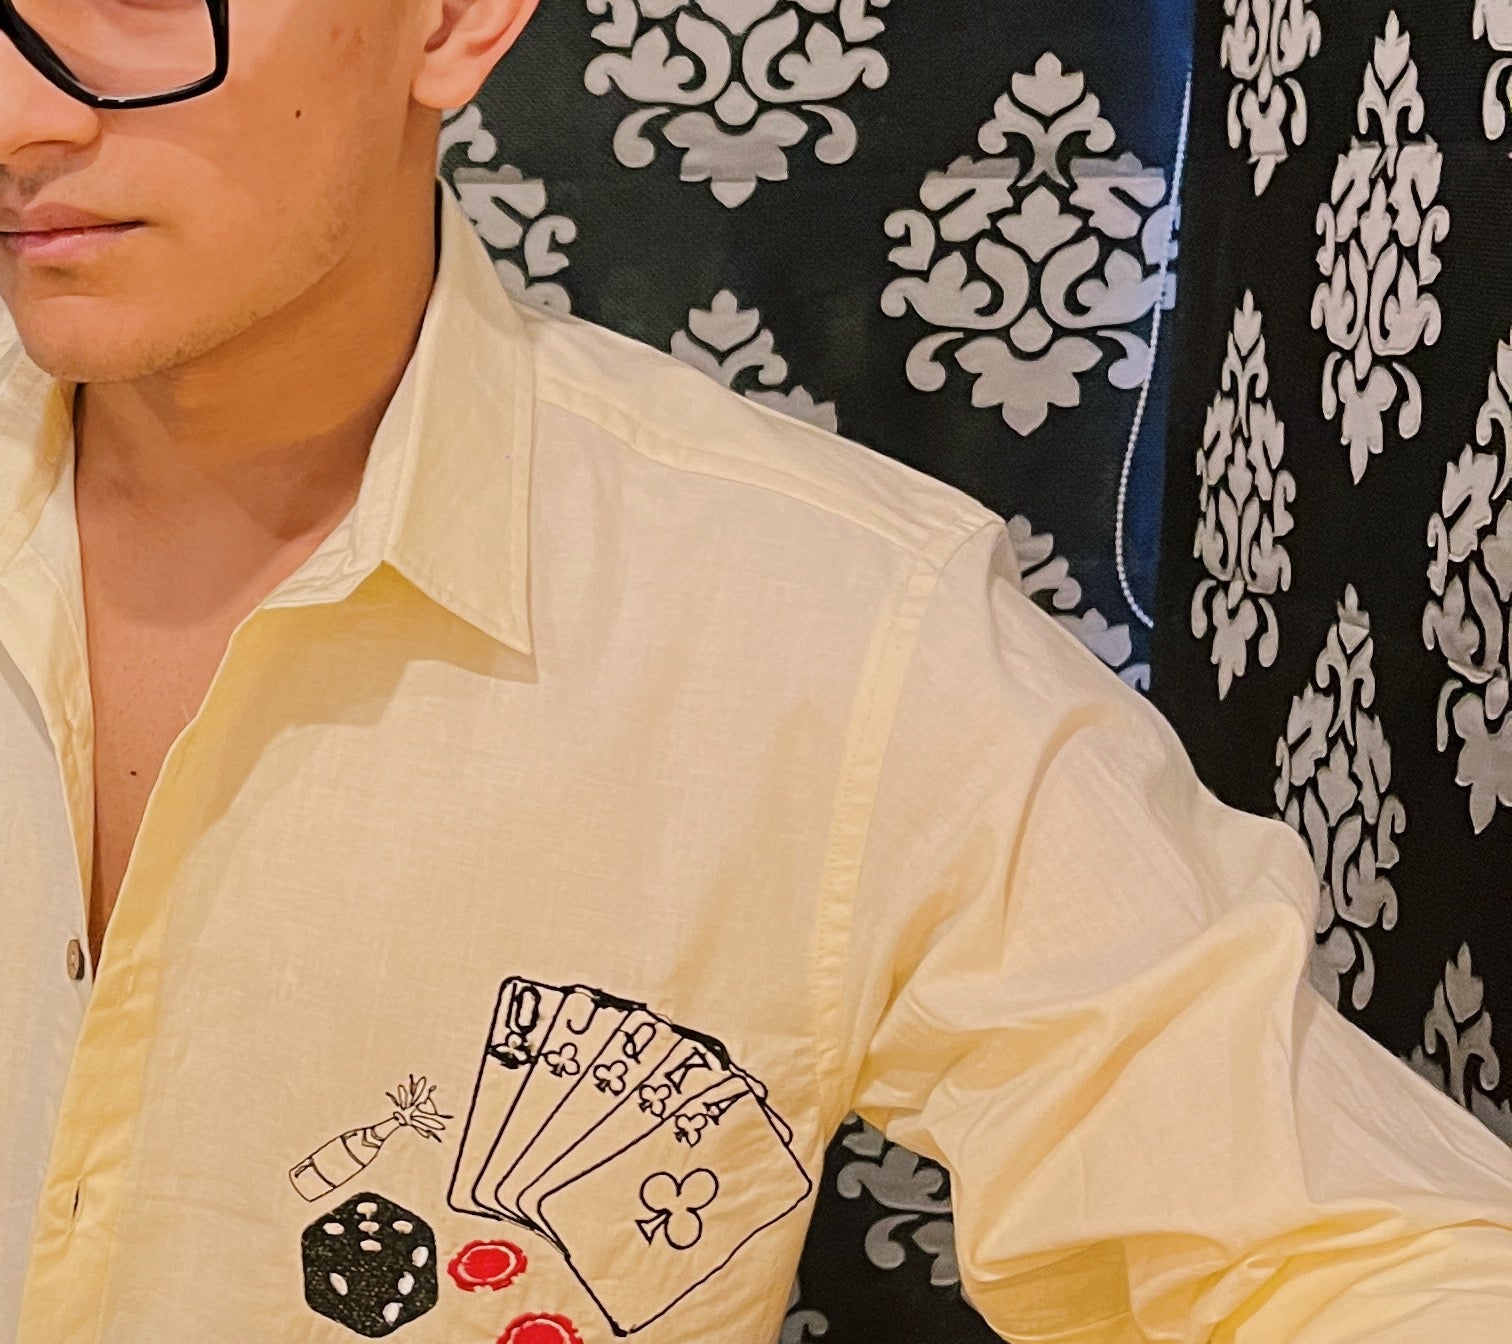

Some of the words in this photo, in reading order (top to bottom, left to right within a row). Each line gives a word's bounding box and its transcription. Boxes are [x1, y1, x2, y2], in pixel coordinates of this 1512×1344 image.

[566, 997, 605, 1035] J
[622, 1022, 657, 1065] Q
[702, 1089, 753, 1126] A
